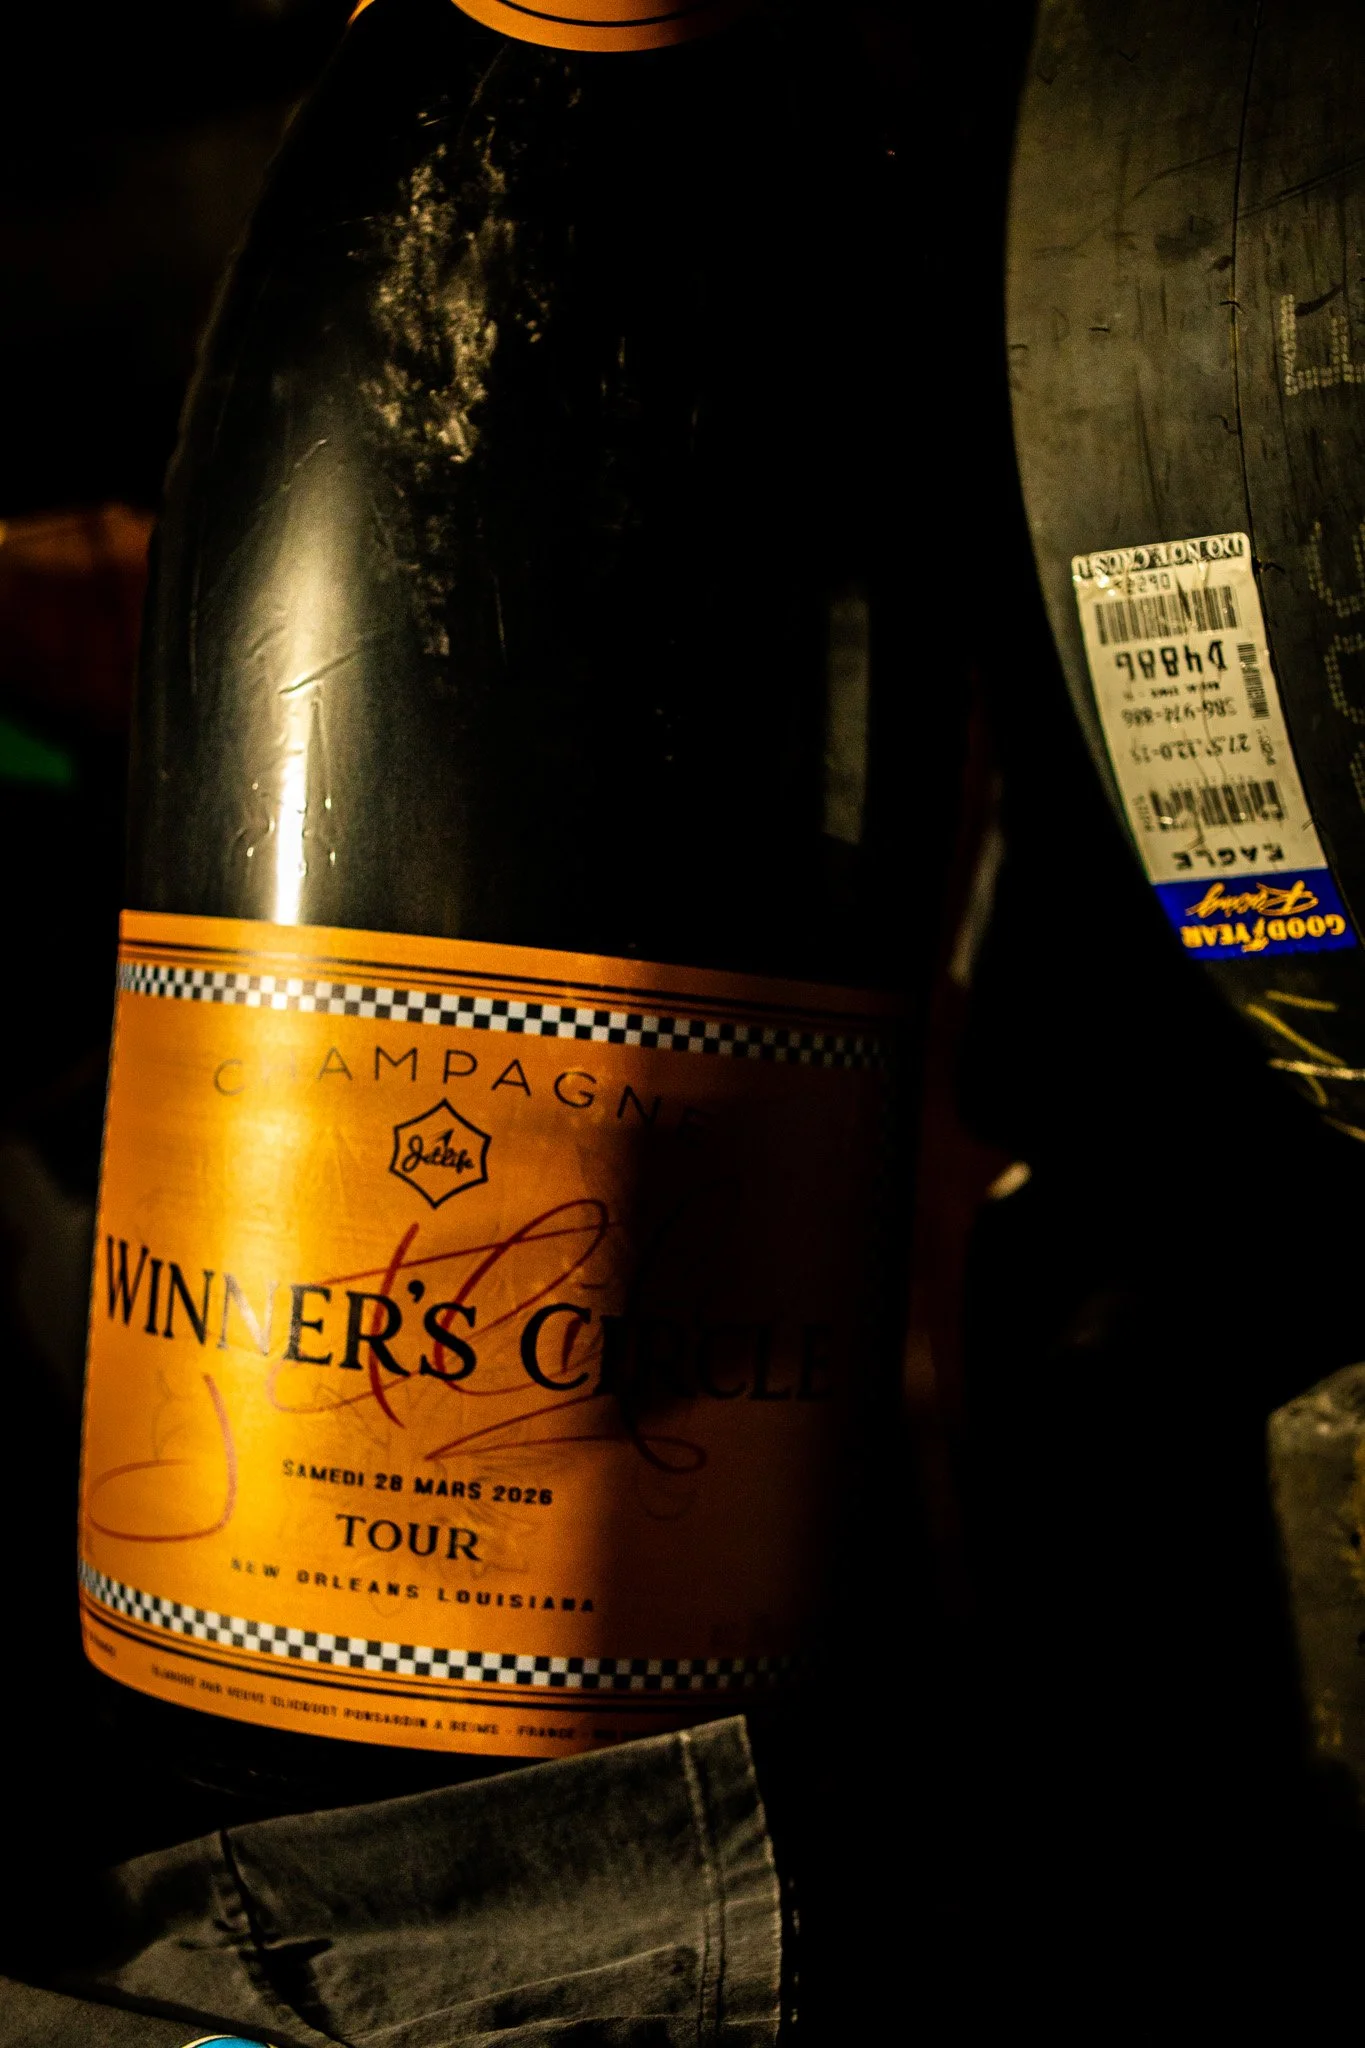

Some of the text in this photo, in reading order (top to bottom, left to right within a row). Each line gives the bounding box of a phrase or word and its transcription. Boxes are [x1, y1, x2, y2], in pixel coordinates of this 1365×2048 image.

[1172, 842, 1285, 872] EAGLE
[1185, 880, 1320, 919] Racing
[1179, 913, 1347, 953] GOODYEAR
[213, 1046, 714, 1147] CAMPAGNE
[104, 1233, 834, 1400] WINNER'S CIRCLE
[282, 1458, 365, 1488] SAMEDI
[413, 1476, 482, 1501] MARS
[491, 1484, 554, 1506] 2026
[335, 1513, 483, 1563] TOUR
[230, 1556, 596, 1613] NEW ORLEANS LOUISIANA
